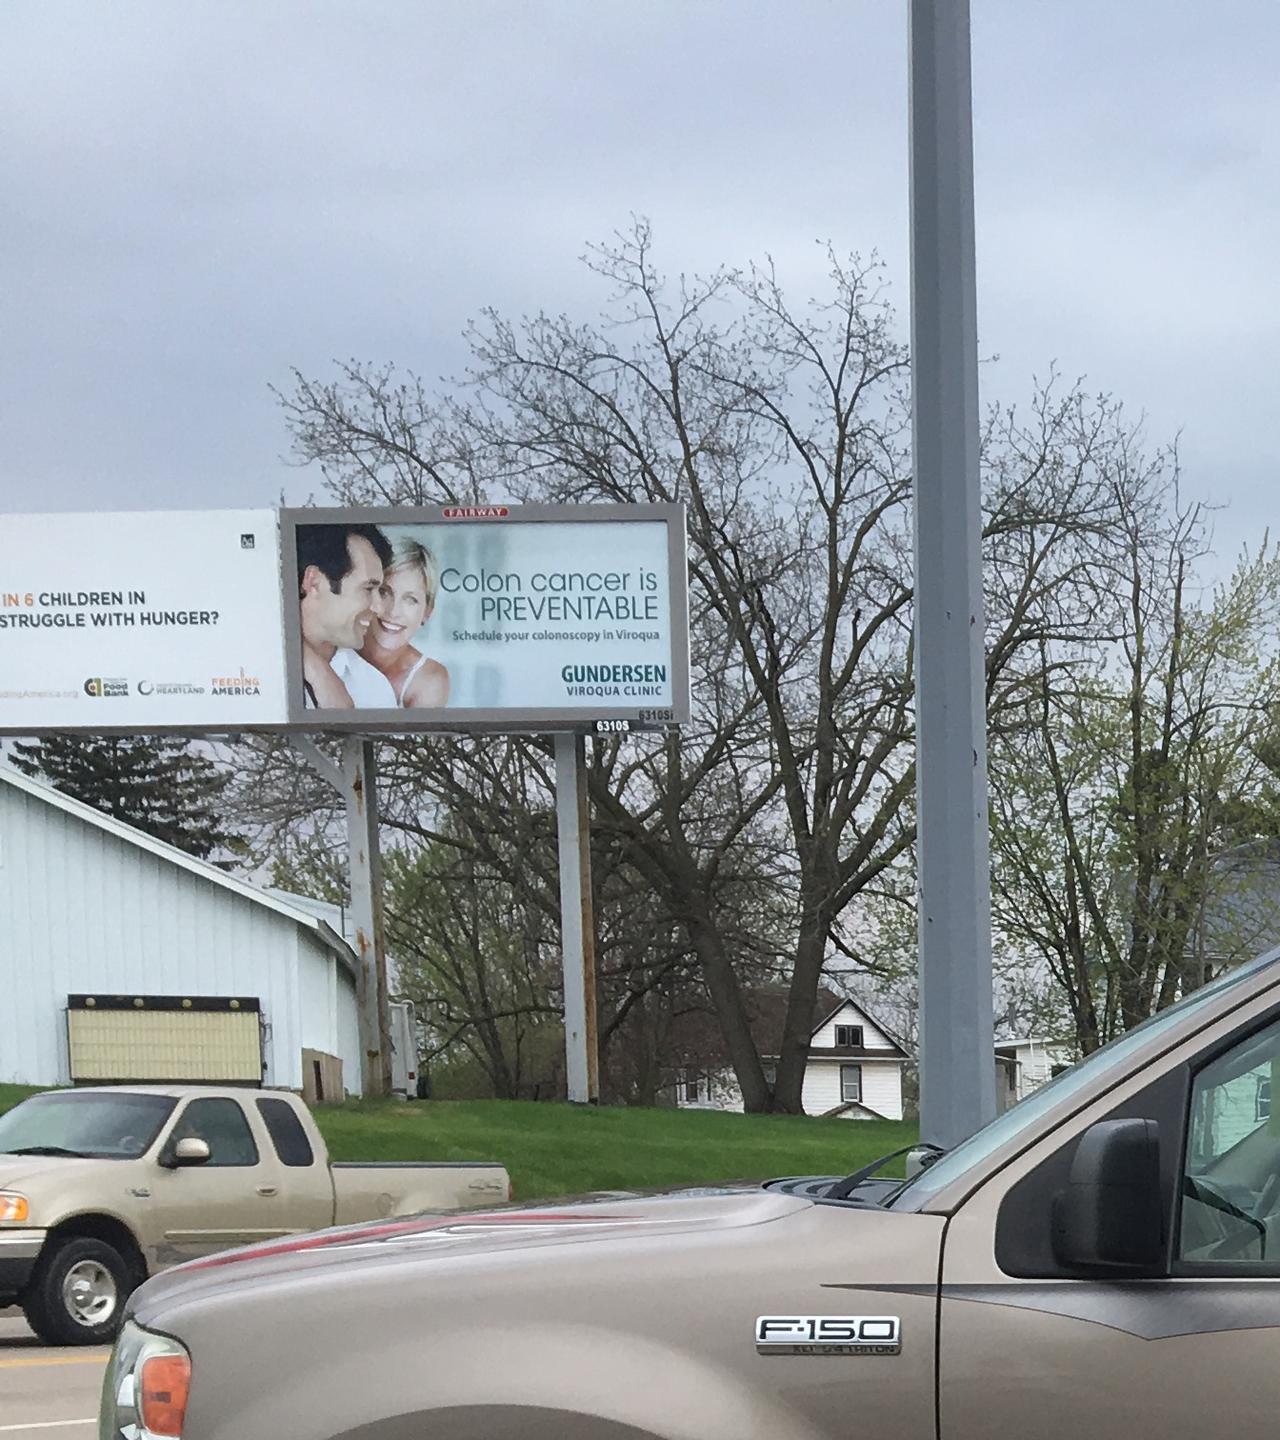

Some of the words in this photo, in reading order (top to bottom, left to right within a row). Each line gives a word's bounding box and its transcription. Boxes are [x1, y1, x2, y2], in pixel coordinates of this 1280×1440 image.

[449, 507, 502, 518] FAIRWAY
[440, 568, 521, 592] Colon
[531, 572, 630, 592] cancer
[639, 568, 657, 591] is
[3, 594, 19, 606] IN
[24, 593, 33, 606] 6
[39, 592, 122, 606] CHILDREN
[129, 591, 145, 604] IN
[481, 596, 658, 620] PREVENTABLE
[0, 613, 85, 627] STRUGGLE
[91, 612, 134, 626] WITH
[141, 611, 218, 625] HUNGER?
[453, 630, 501, 641] Schedule
[504, 632, 528, 642] your
[532, 630, 600, 642] colonoscopy
[603, 630, 613, 640] in
[616, 629, 660, 641] Viroqua
[562, 665, 666, 682] GUNDERSEN
[212, 687, 260, 695] AMERICA
[566, 686, 620, 697] VIROQUA
[624, 686, 662, 695] CLINIC
[596, 721, 630, 731] 6310S
